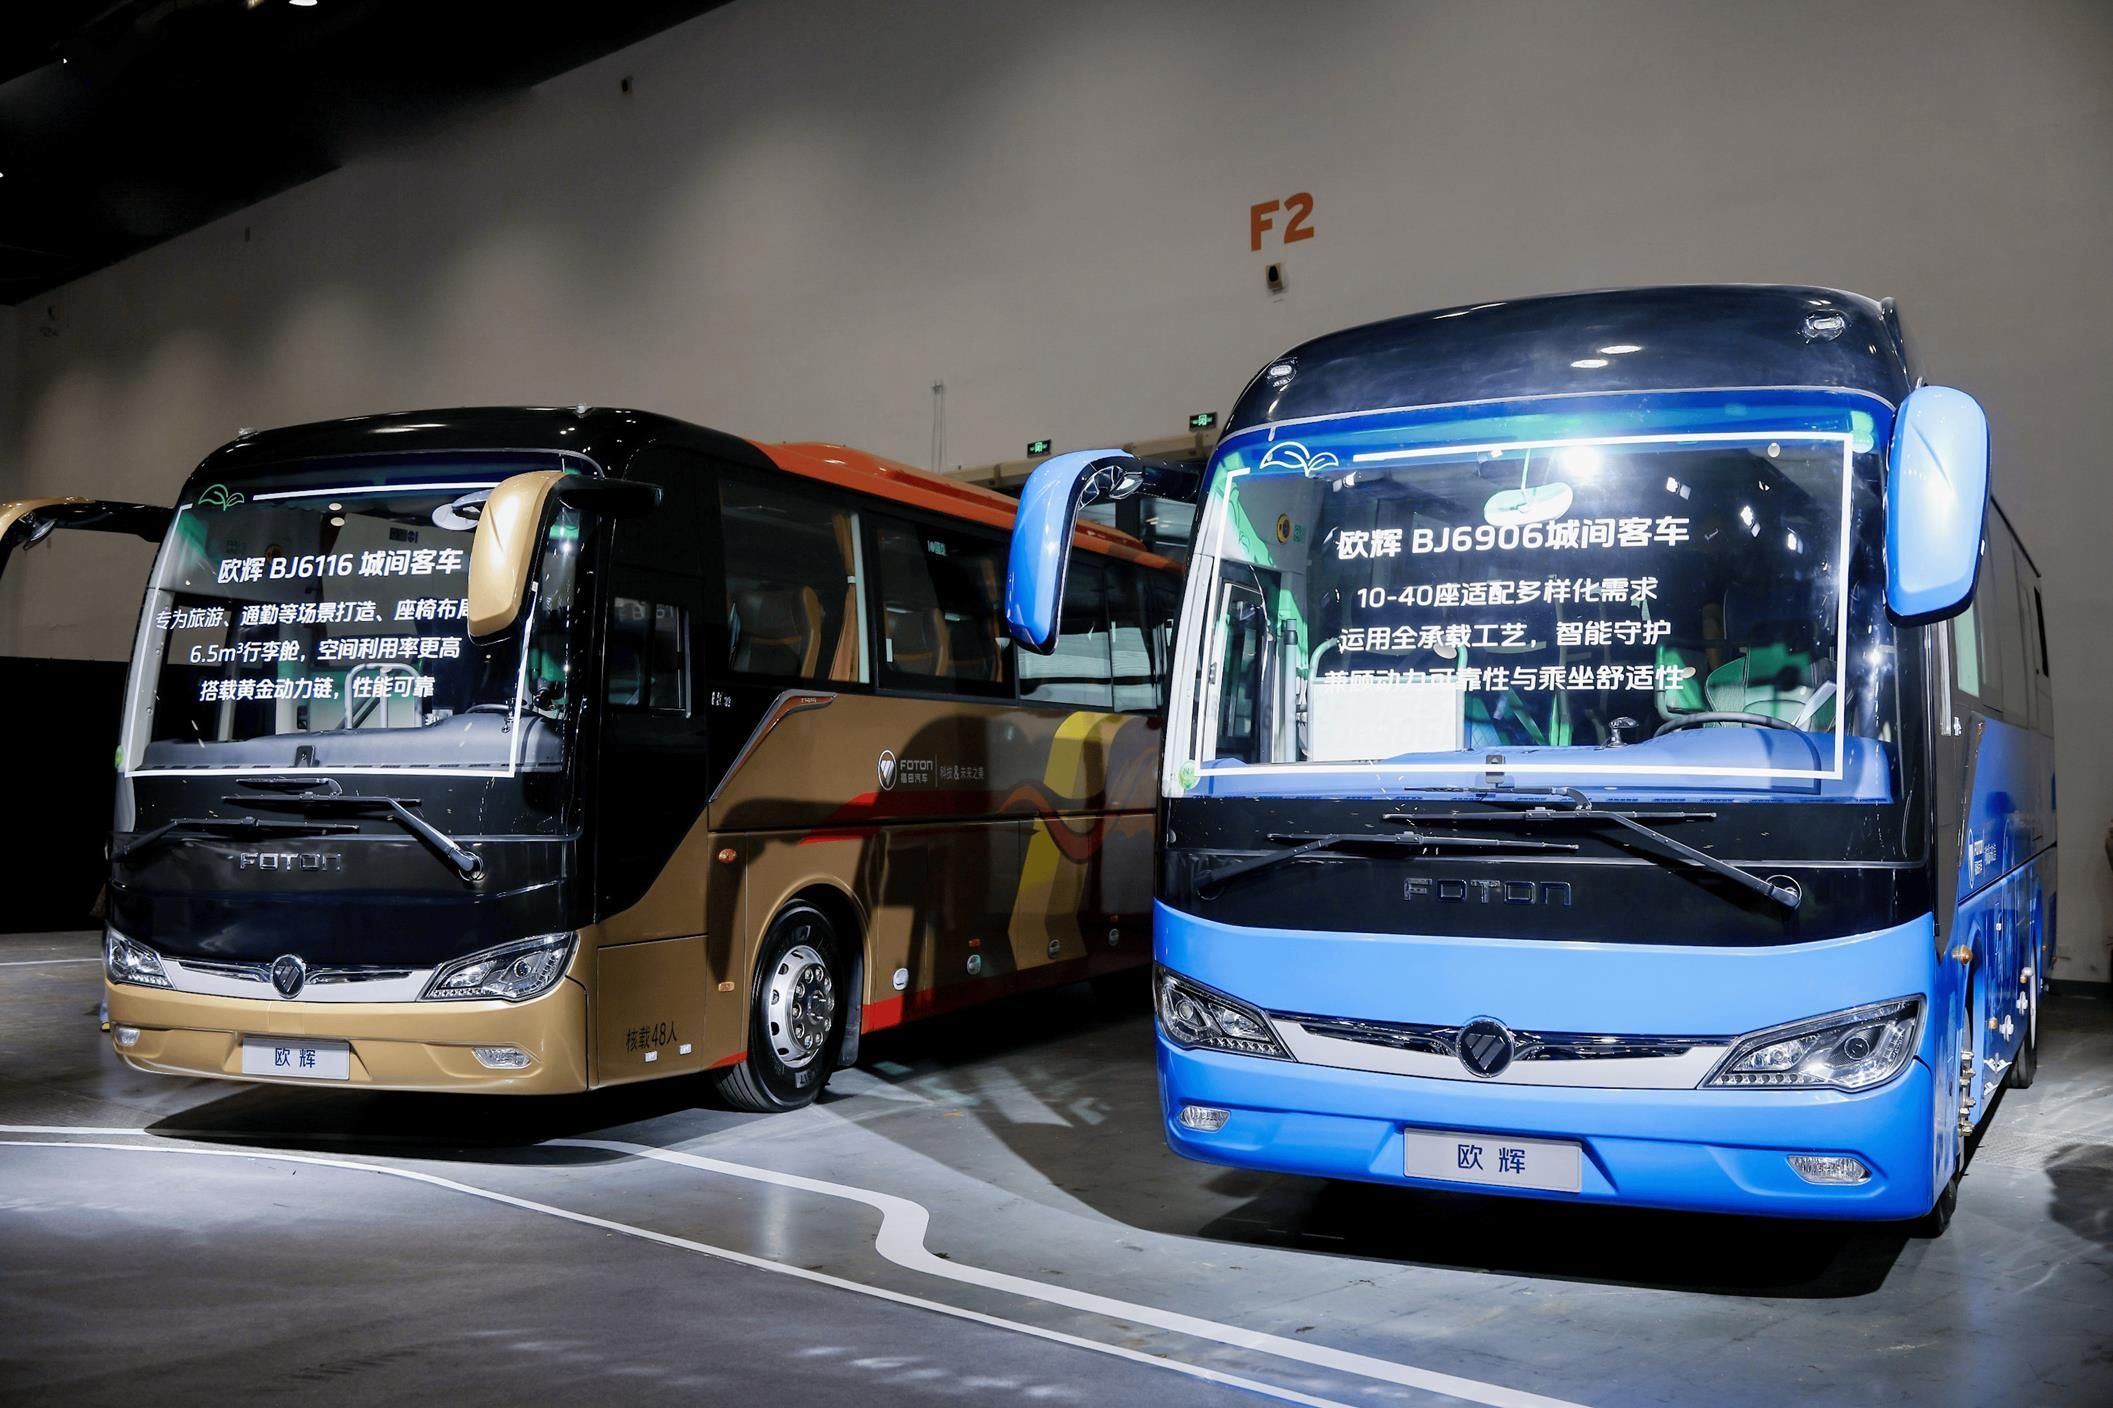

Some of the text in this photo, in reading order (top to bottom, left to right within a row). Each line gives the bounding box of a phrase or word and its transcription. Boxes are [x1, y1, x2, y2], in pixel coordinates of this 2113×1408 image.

[1250, 192, 1315, 252] F2
[1337, 515, 1690, 560] 欧辉 BJ6906城间客车
[217, 548, 464, 584] 欧辉 BJ6116 城间客车
[1357, 576, 1659, 609] 10-40座适配多样化需求
[900, 760, 933, 771] FOTON
[240, 852, 341, 871] FOTON
[1404, 877, 1572, 906] FOTON
[625, 1020, 678, 1053] 核载48人
